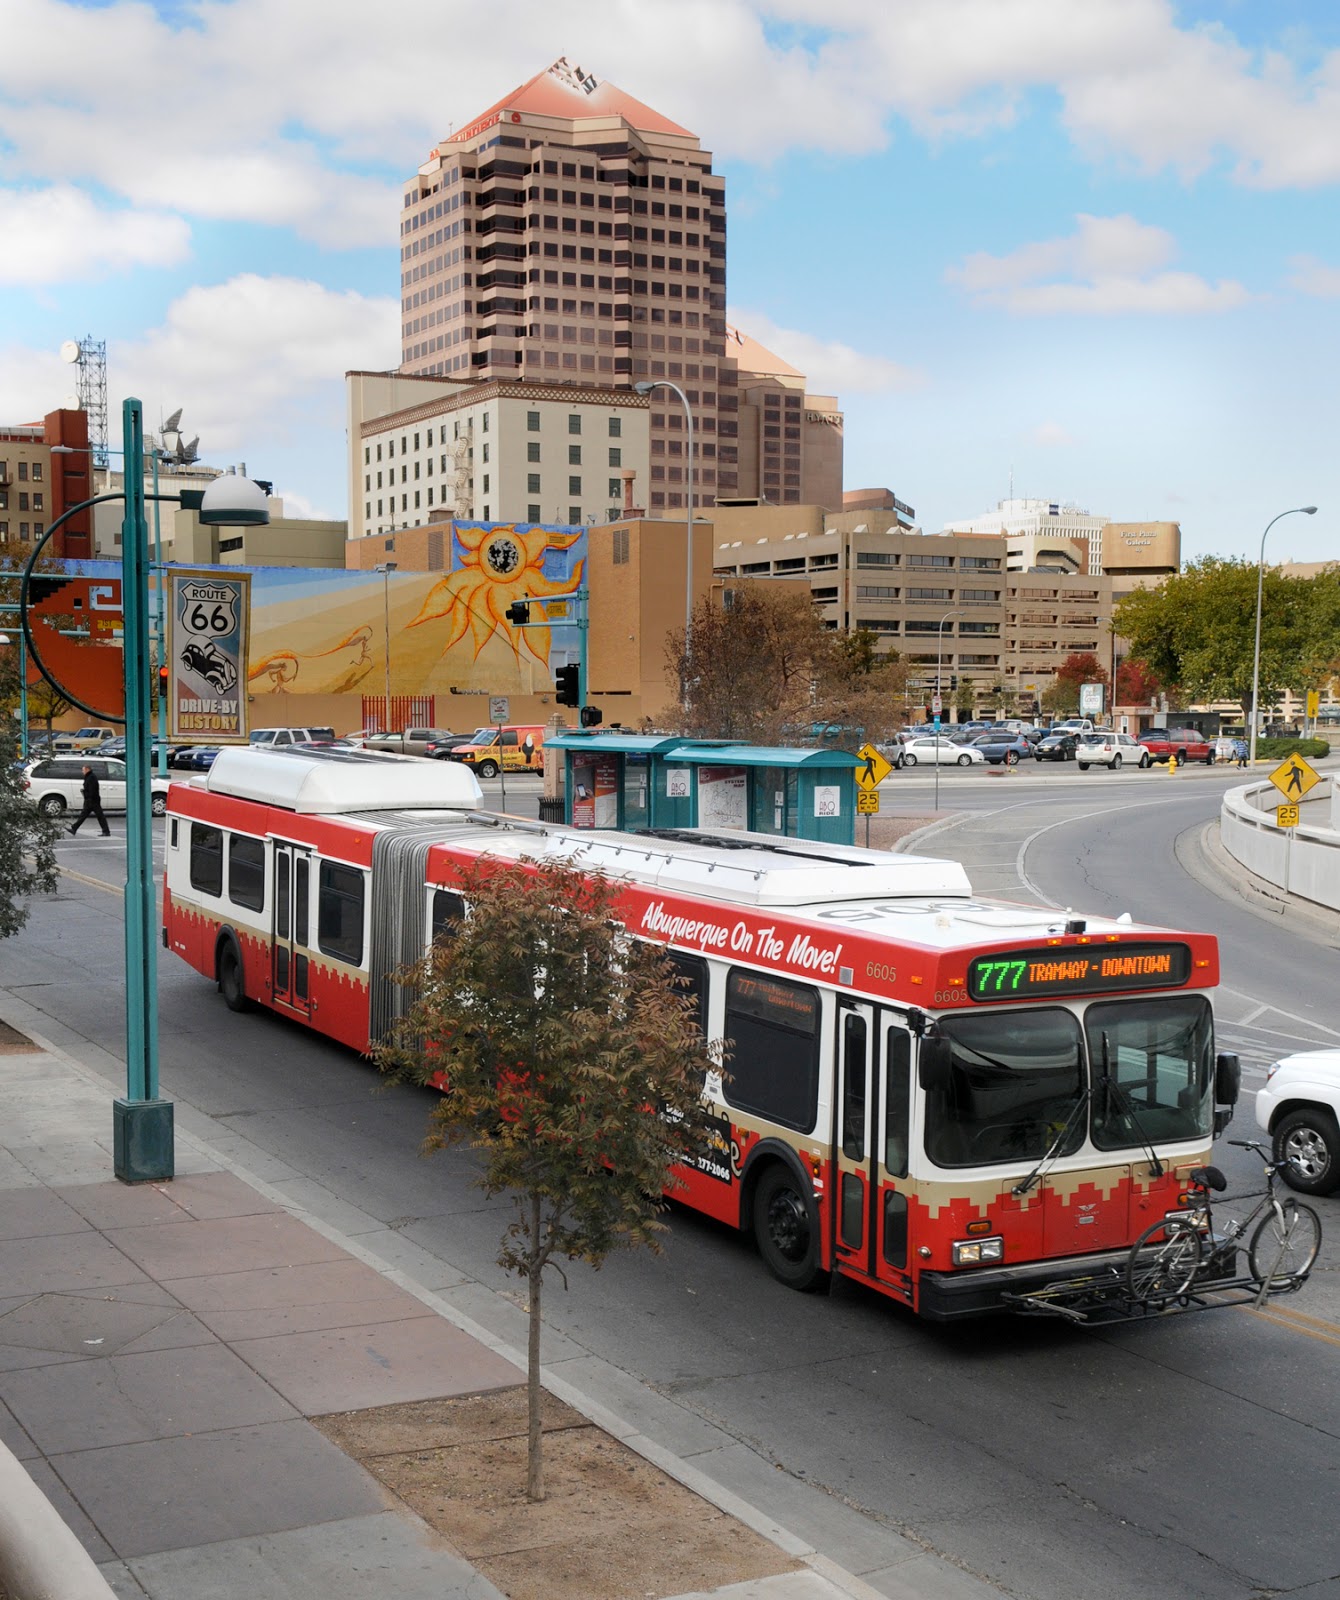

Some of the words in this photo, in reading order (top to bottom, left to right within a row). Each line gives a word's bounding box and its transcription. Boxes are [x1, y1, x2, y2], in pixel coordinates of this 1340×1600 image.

[192, 589, 226, 600] ROUTE
[191, 603, 228, 632] 66
[180, 698, 238, 714] DRIVE-BY
[180, 715, 238, 730] HISTORY
[859, 794, 877, 805] 25
[1280, 807, 1297, 819] 25
[641, 901, 727, 951] Albuquerque
[730, 922, 754, 953] On
[755, 926, 784, 961] The
[786, 934, 843, 974] Move!
[866, 961, 897, 982] 6605
[977, 961, 1027, 991] 777
[1029, 960, 1089, 982] TRAMWAY
[1101, 955, 1171, 977] DOWNTOWN
[737, 977, 757, 996] 777
[934, 988, 968, 1003] 6605
[697, 1156, 731, 1181] 277-2066
